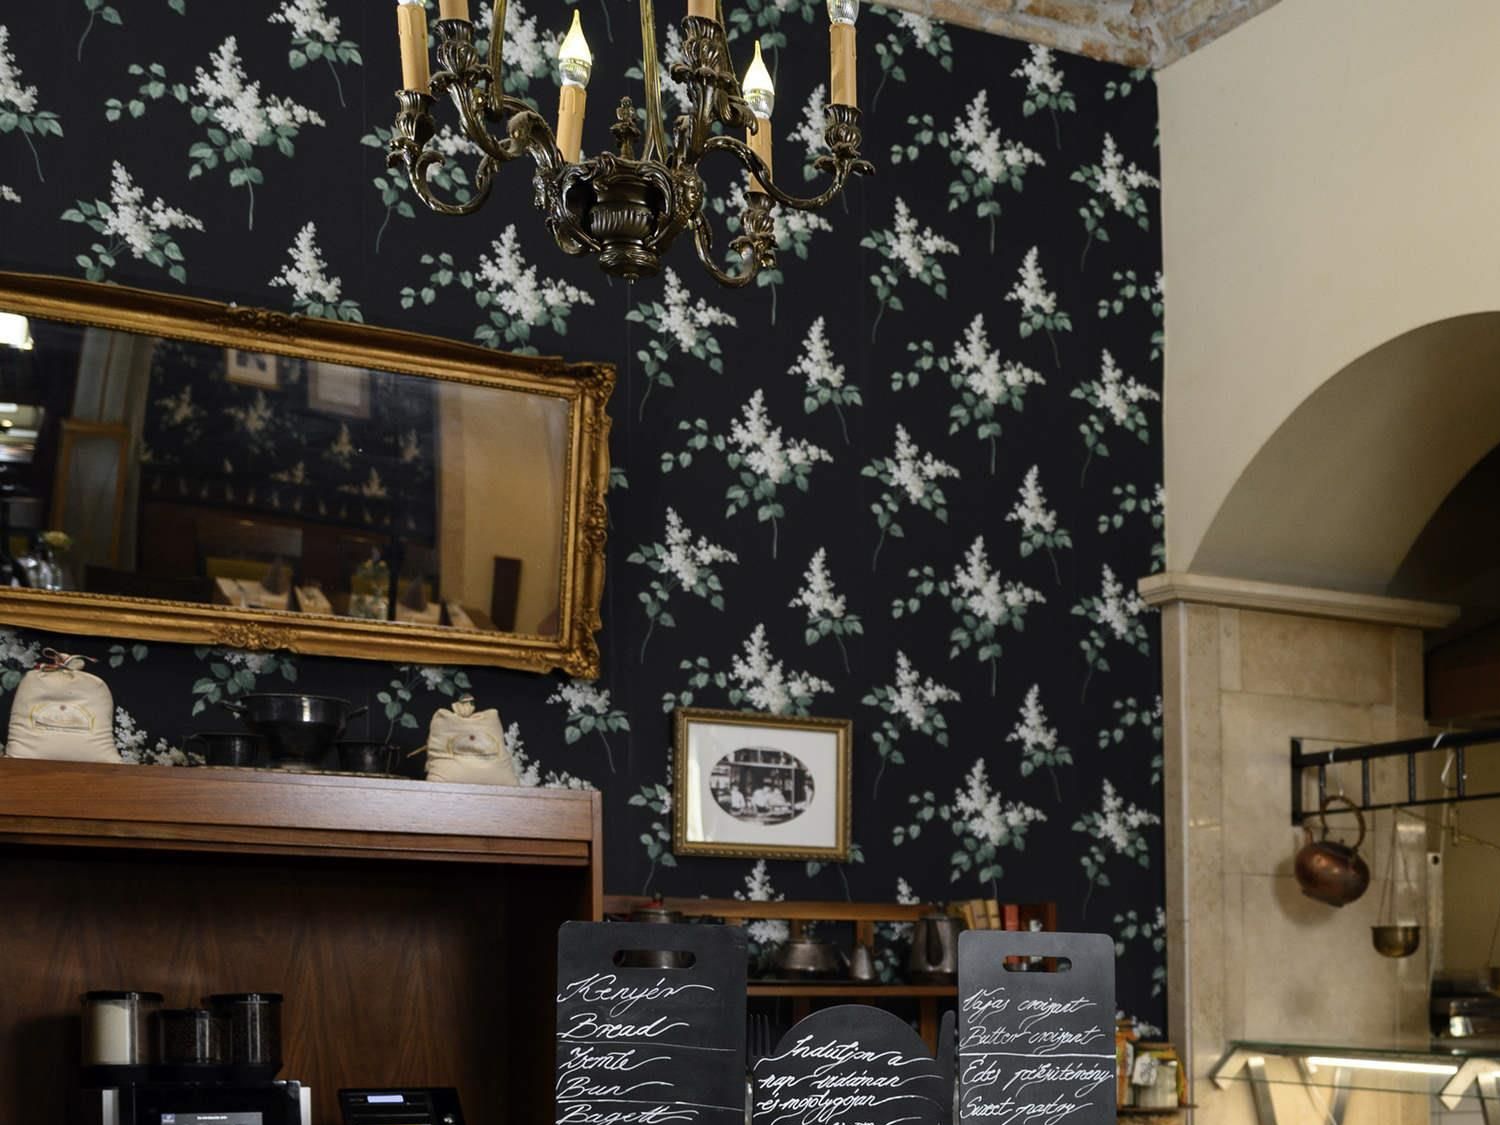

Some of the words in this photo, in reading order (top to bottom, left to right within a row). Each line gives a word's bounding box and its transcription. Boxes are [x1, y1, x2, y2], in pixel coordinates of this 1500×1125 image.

[557, 973, 709, 1018] Kenyér
[556, 1013, 689, 1039] Bread
[960, 1026, 1028, 1050] Butter
[556, 1076, 665, 1100] Bun
[960, 1096, 1015, 1119] Sweet
